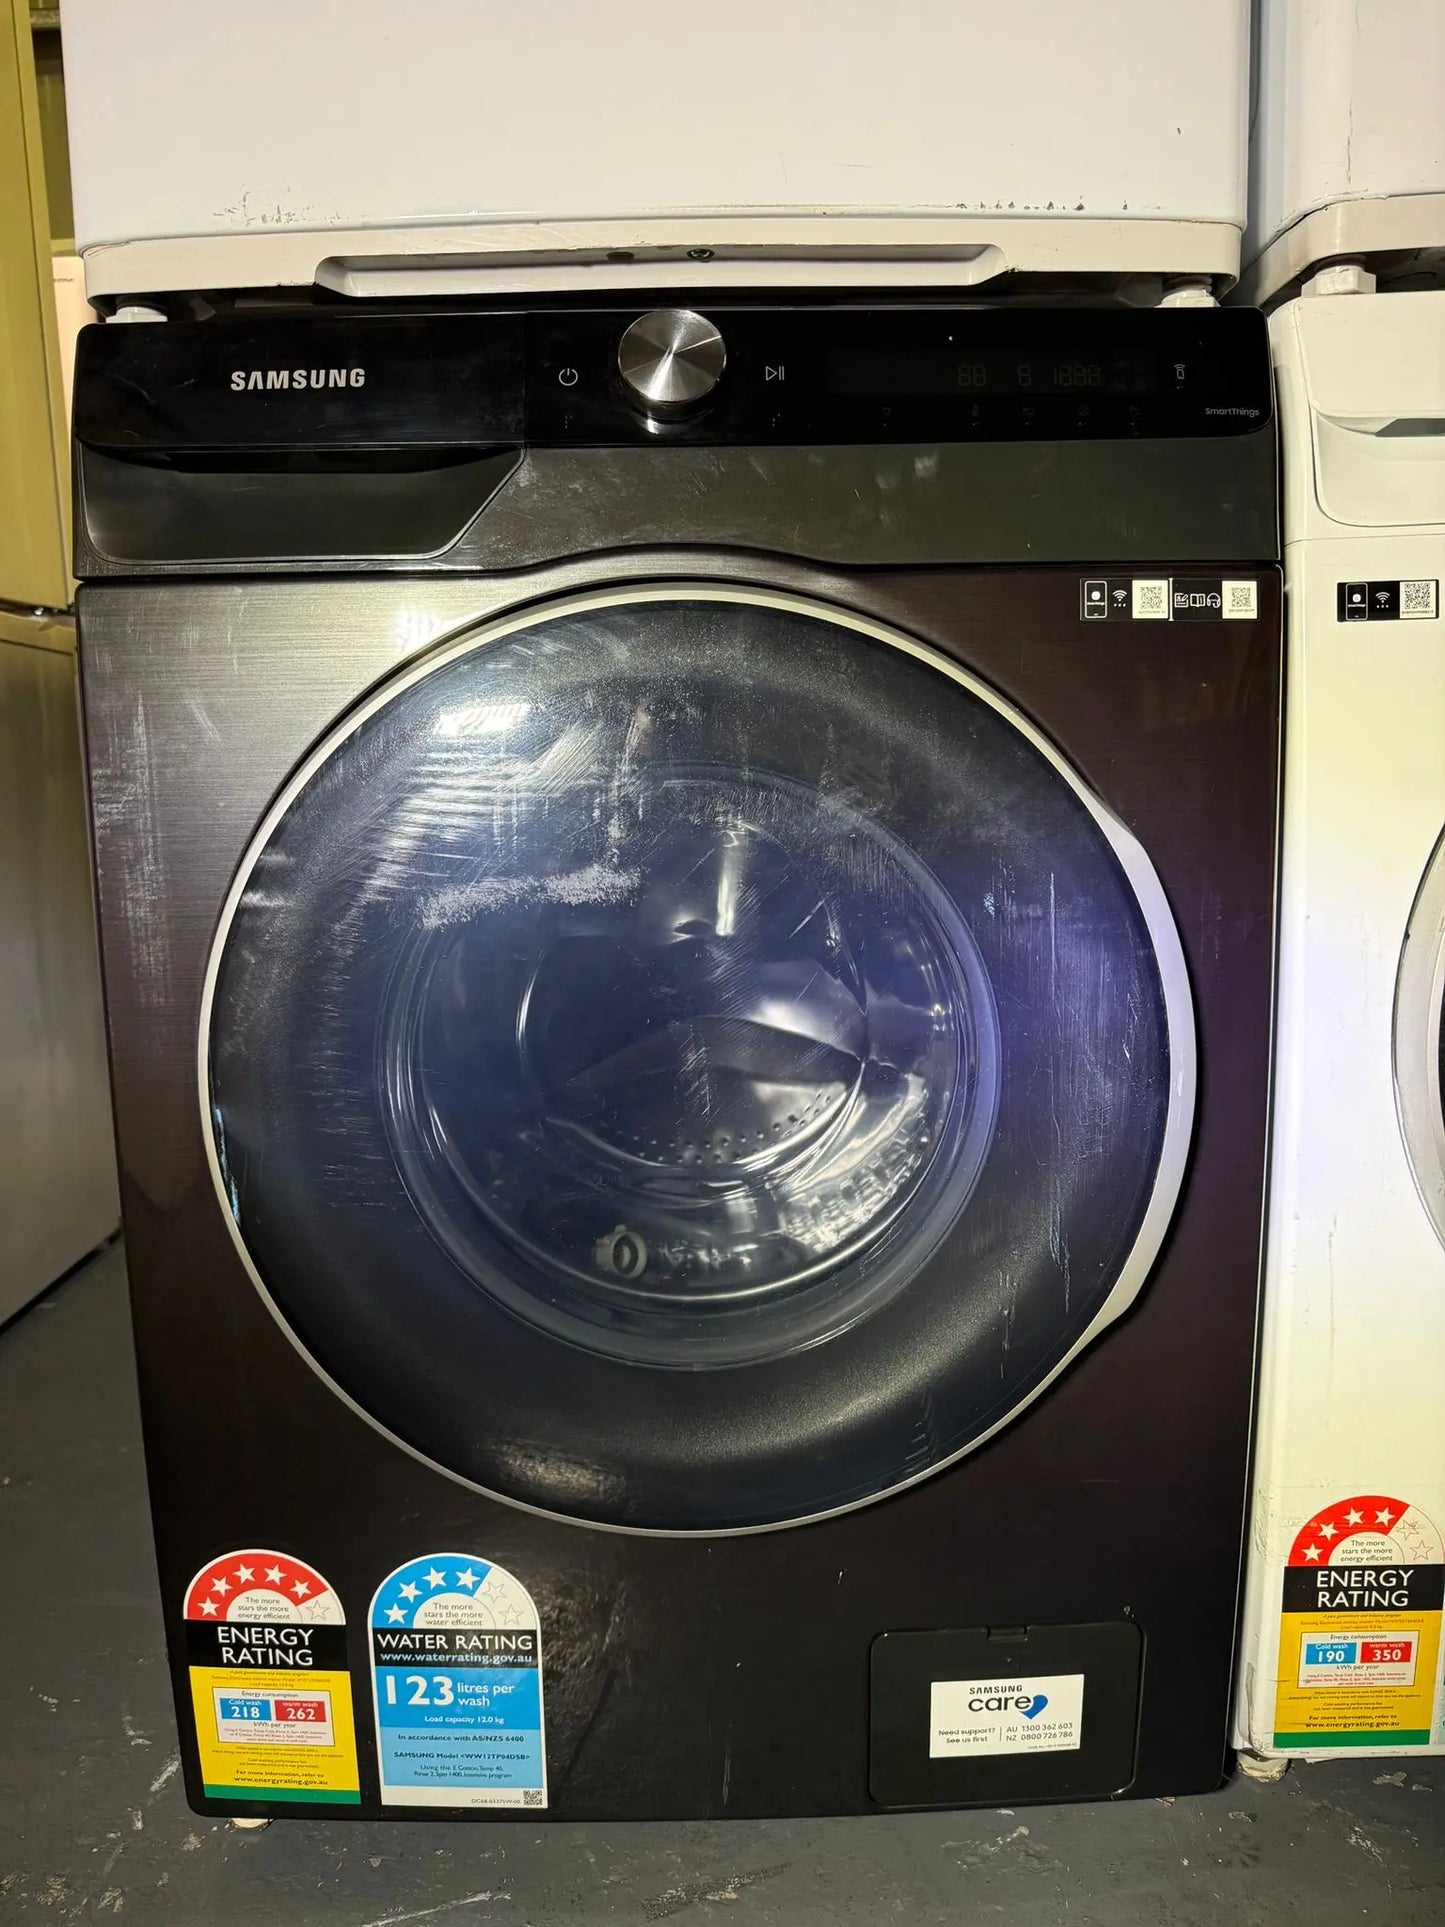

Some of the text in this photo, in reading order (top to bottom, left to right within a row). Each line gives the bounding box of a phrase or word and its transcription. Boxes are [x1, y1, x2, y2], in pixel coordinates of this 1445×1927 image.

[230, 367, 366, 391] SAMSUNG
[1205, 407, 1260, 418] SmartThings
[1316, 1569, 1414, 1588] ENERGY
[1317, 1590, 1409, 1608] RATING
[433, 1602, 450, 1610] The
[263, 1612, 291, 1620] efficient
[217, 1626, 314, 1646] ENERGY
[377, 1633, 533, 1650] WATER RATING
[221, 1646, 314, 1666] RATING
[380, 1652, 532, 1665] www.waterrating.gov.au
[1317, 1651, 1345, 1662] 190
[1372, 1649, 1402, 1661] 350
[241, 1690, 262, 1698] Energy
[385, 1675, 515, 1706] 123 litres per
[969, 1684, 1023, 1695] SAMSUNG
[457, 1695, 490, 1706] wash
[968, 1695, 1031, 1712] care
[231, 1706, 260, 1718] 218
[286, 1708, 316, 1720] 262
[424, 1715, 505, 1725] Load capacity 12.0 kg
[1305, 1720, 1400, 1728] www.energyrating.gov.au
[961, 1727, 996, 1736] support?
[1057, 1722, 1073, 1730] 603
[1020, 1733, 1042, 1741] 0800
[1042, 1732, 1058, 1740] 726
[1058, 1731, 1073, 1739] 786
[394, 1751, 435, 1759] SAMSUNG
[234, 1777, 328, 1786] www.energyrating.gov.au
